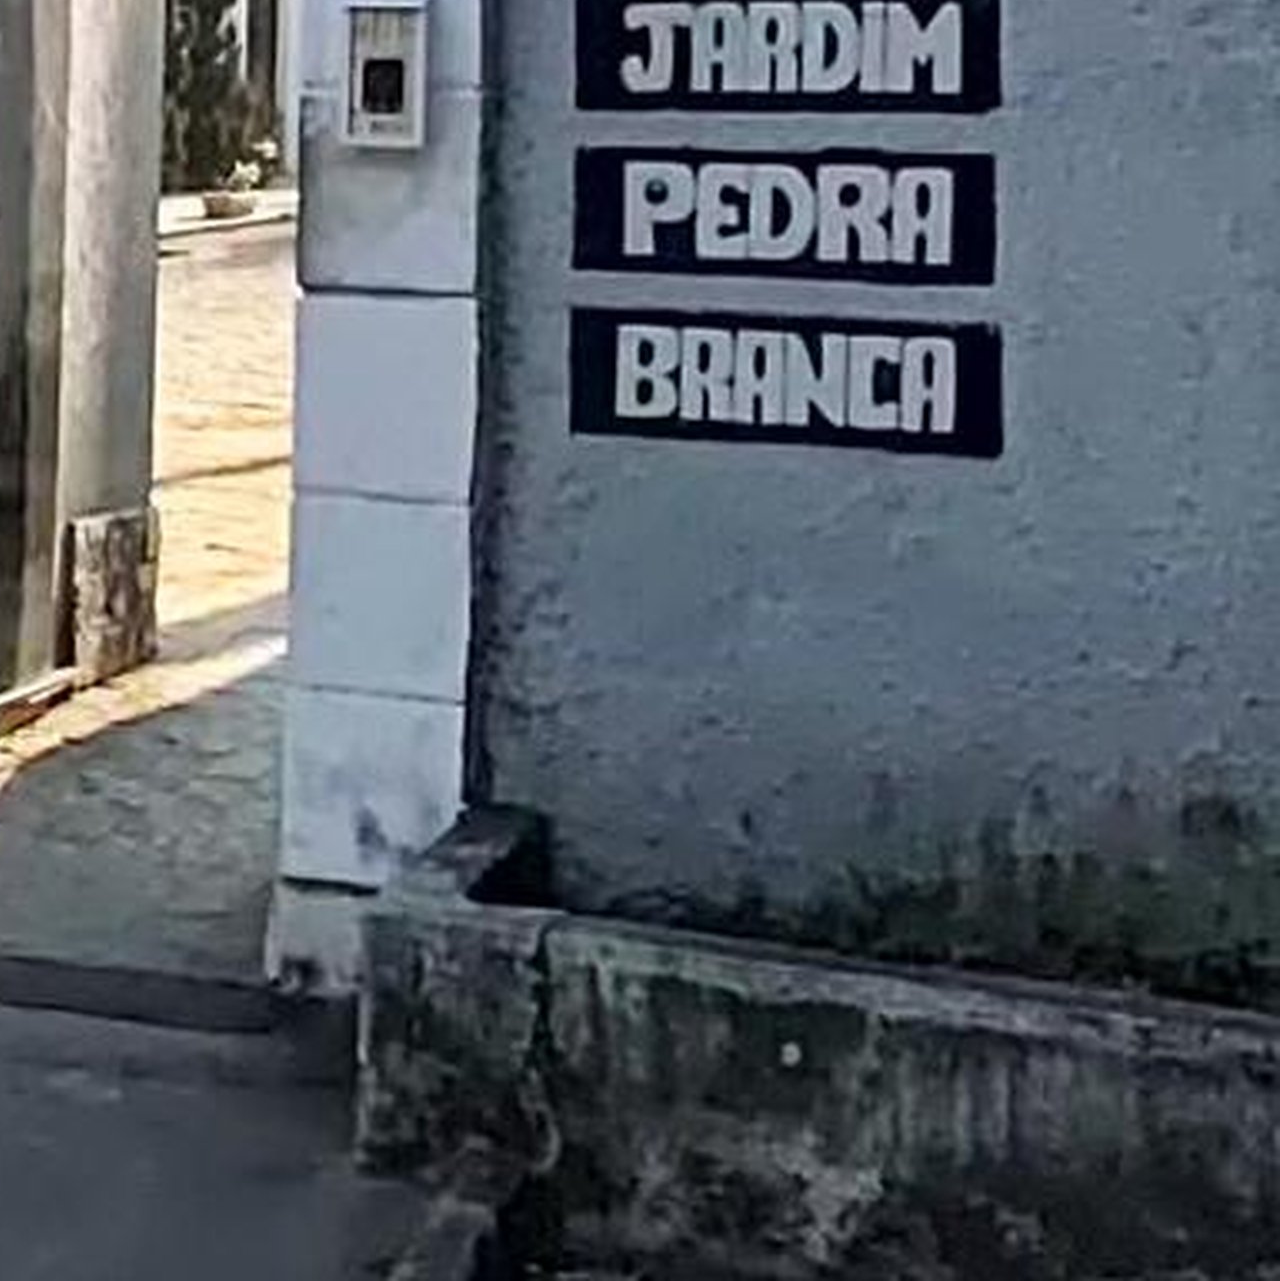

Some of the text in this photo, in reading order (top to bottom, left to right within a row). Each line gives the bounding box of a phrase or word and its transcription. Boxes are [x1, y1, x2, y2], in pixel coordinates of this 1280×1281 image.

[621, 2, 963, 95] JARDIM
[622, 161, 953, 265] PEDRA
[615, 324, 958, 435] BRANCA
